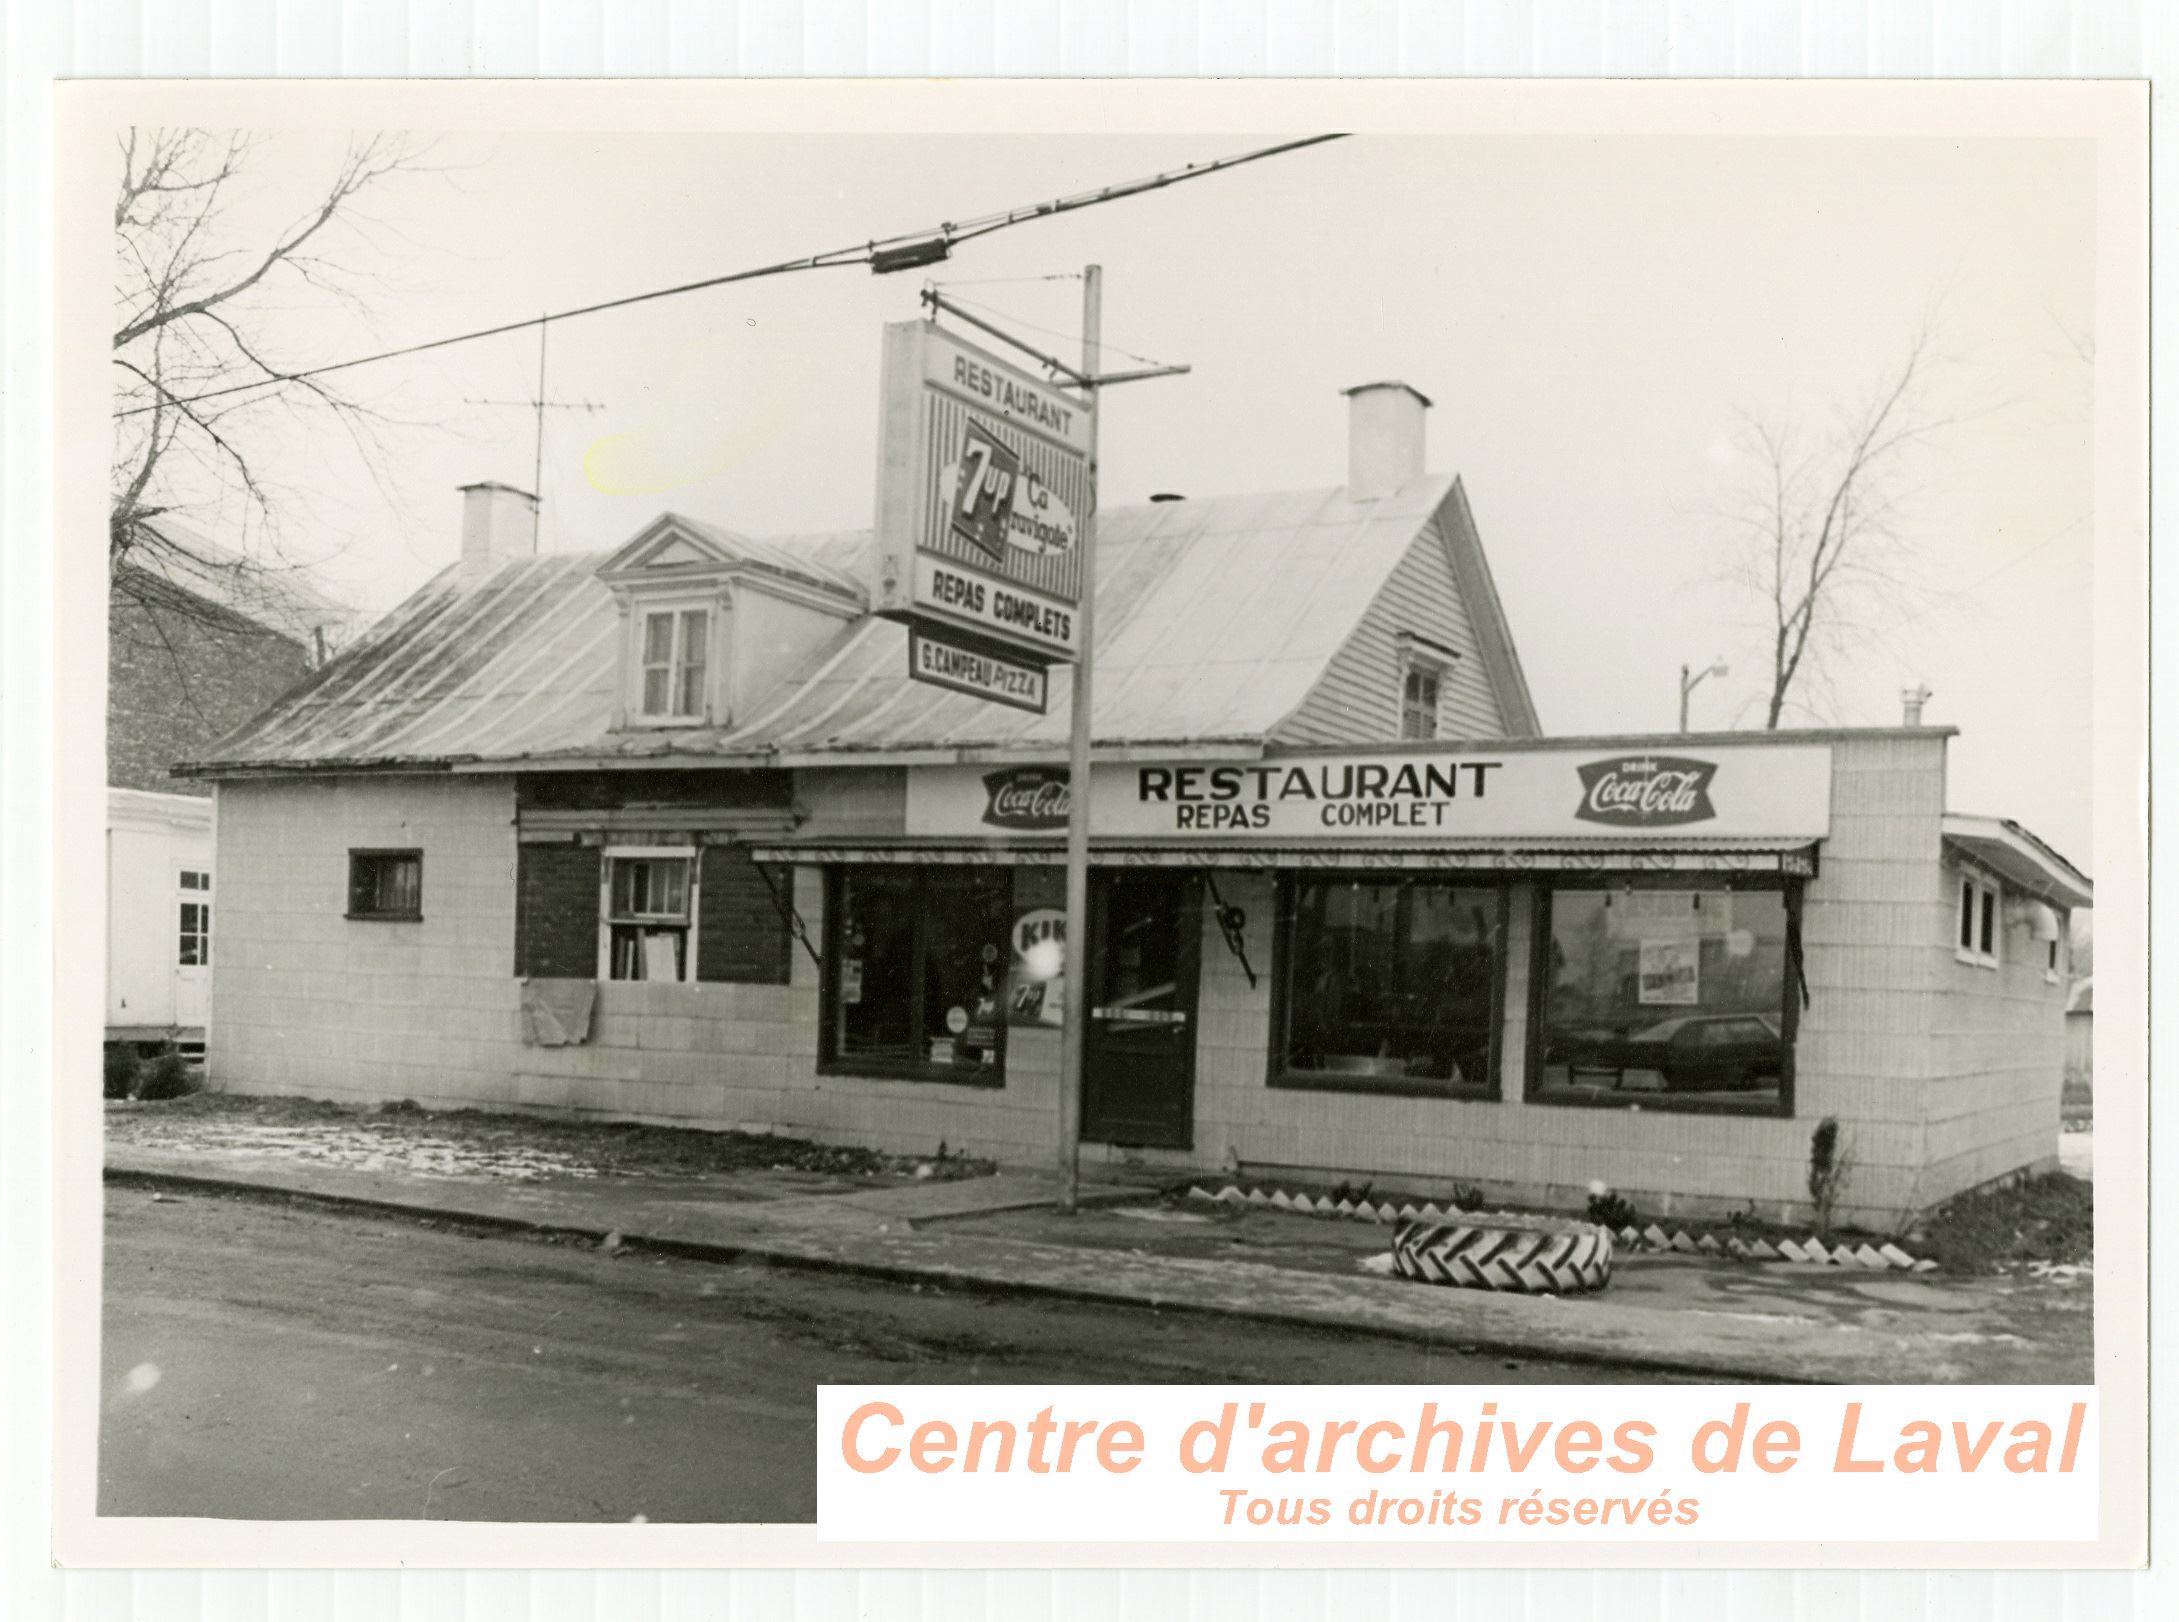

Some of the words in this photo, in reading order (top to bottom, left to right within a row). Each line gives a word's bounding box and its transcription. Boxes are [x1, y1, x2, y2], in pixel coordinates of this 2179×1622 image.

[954, 354, 1072, 435] RESTAURANT
[932, 569, 985, 614] REPAS
[993, 590, 1070, 642] COMPLETS
[993, 665, 1036, 699] PIZZA
[1139, 763, 1502, 801] RESTAURANT
[1622, 762, 1658, 772] DRINK
[1590, 771, 1701, 812] Coca-Cola
[1176, 804, 1270, 829] REPAS
[1321, 802, 1451, 827] COMPLET
